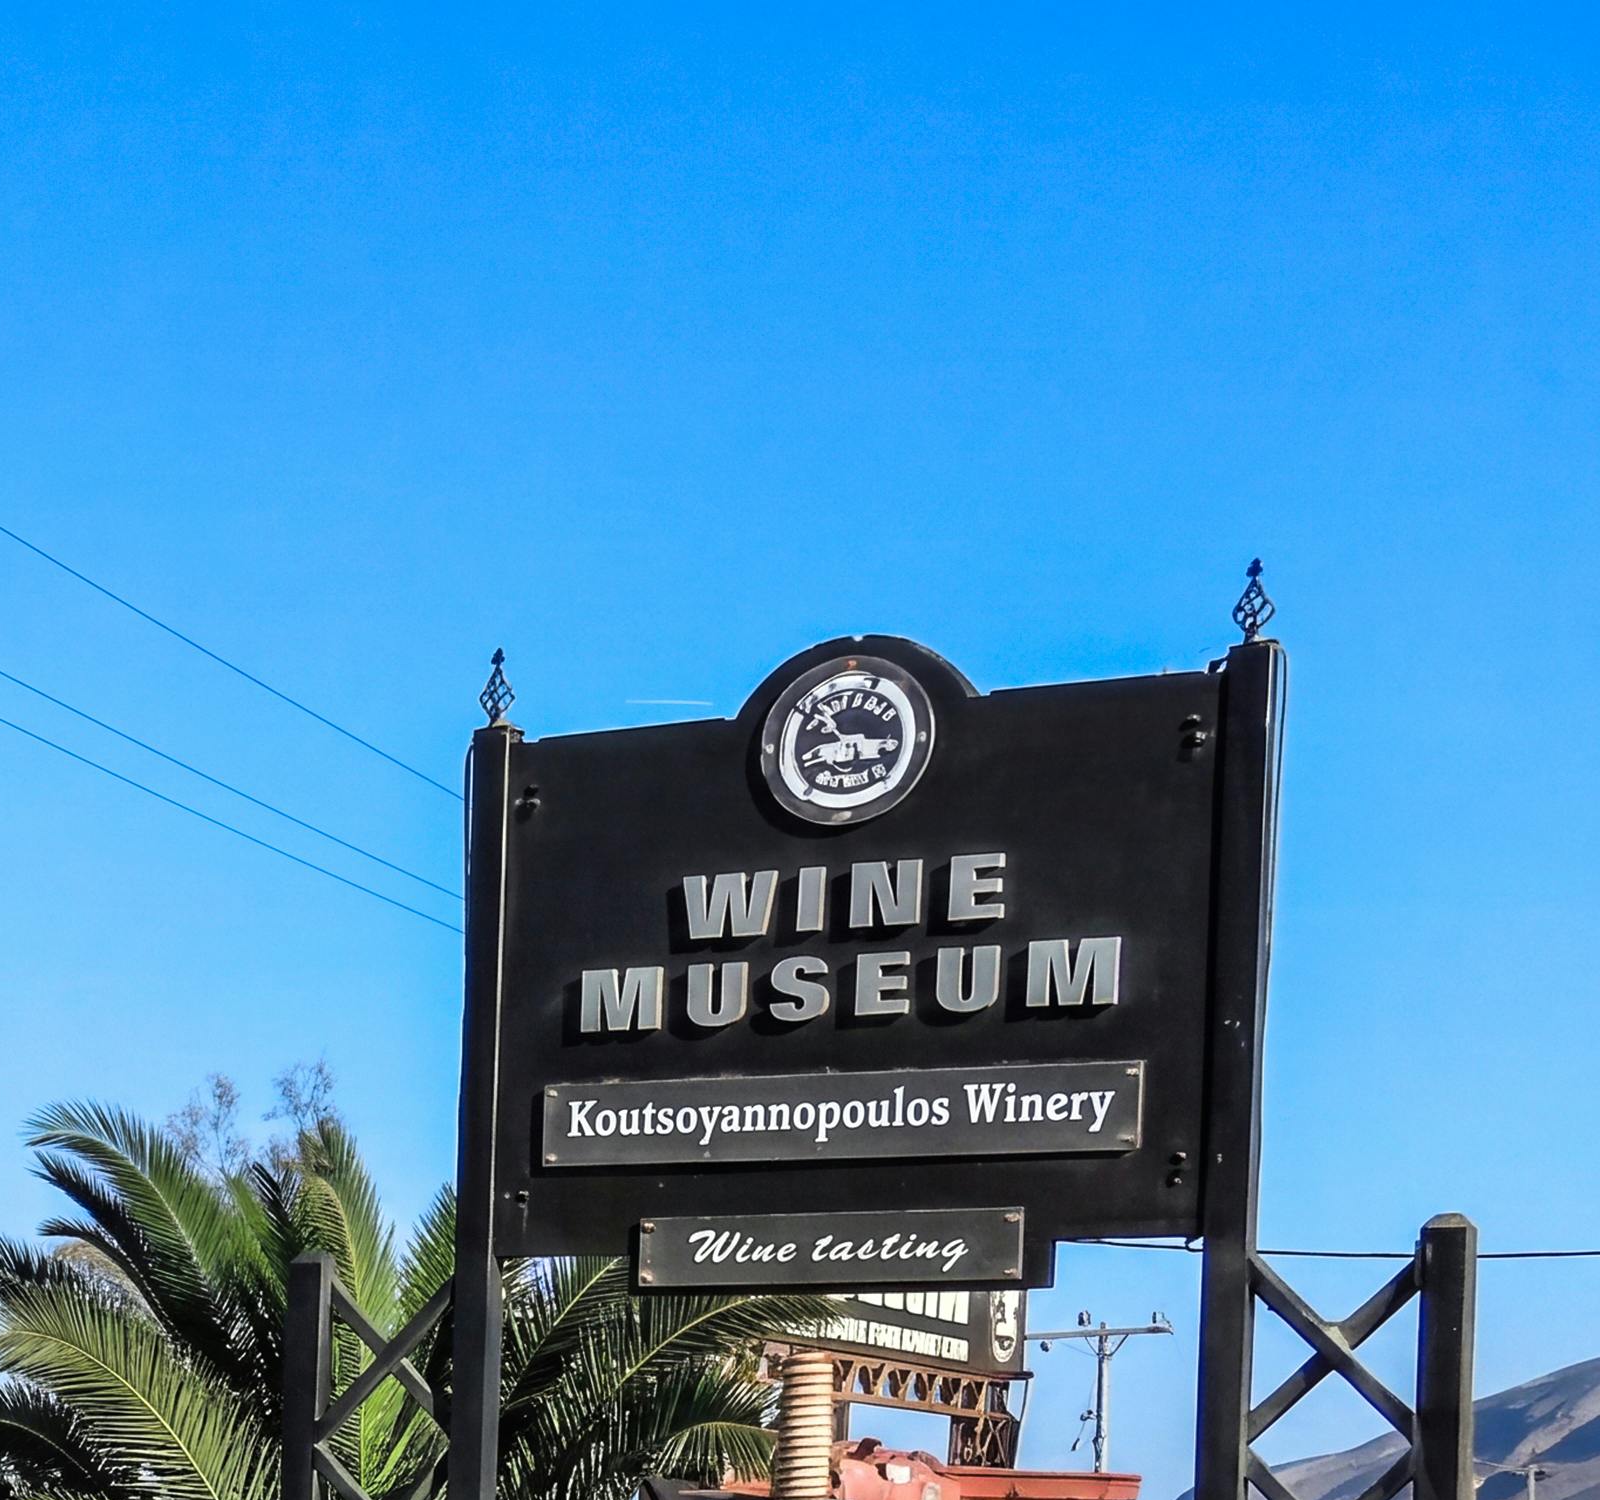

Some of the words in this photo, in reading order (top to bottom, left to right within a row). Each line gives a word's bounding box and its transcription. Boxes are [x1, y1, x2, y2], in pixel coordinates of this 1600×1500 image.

[682, 851, 1007, 940] WINE
[579, 935, 1122, 1034] MUSEUM
[566, 1087, 950, 1143] Koutsoyannopoulos
[962, 1083, 1116, 1132] Winery
[688, 1229, 797, 1265] Wine
[811, 1231, 969, 1268] tasting
